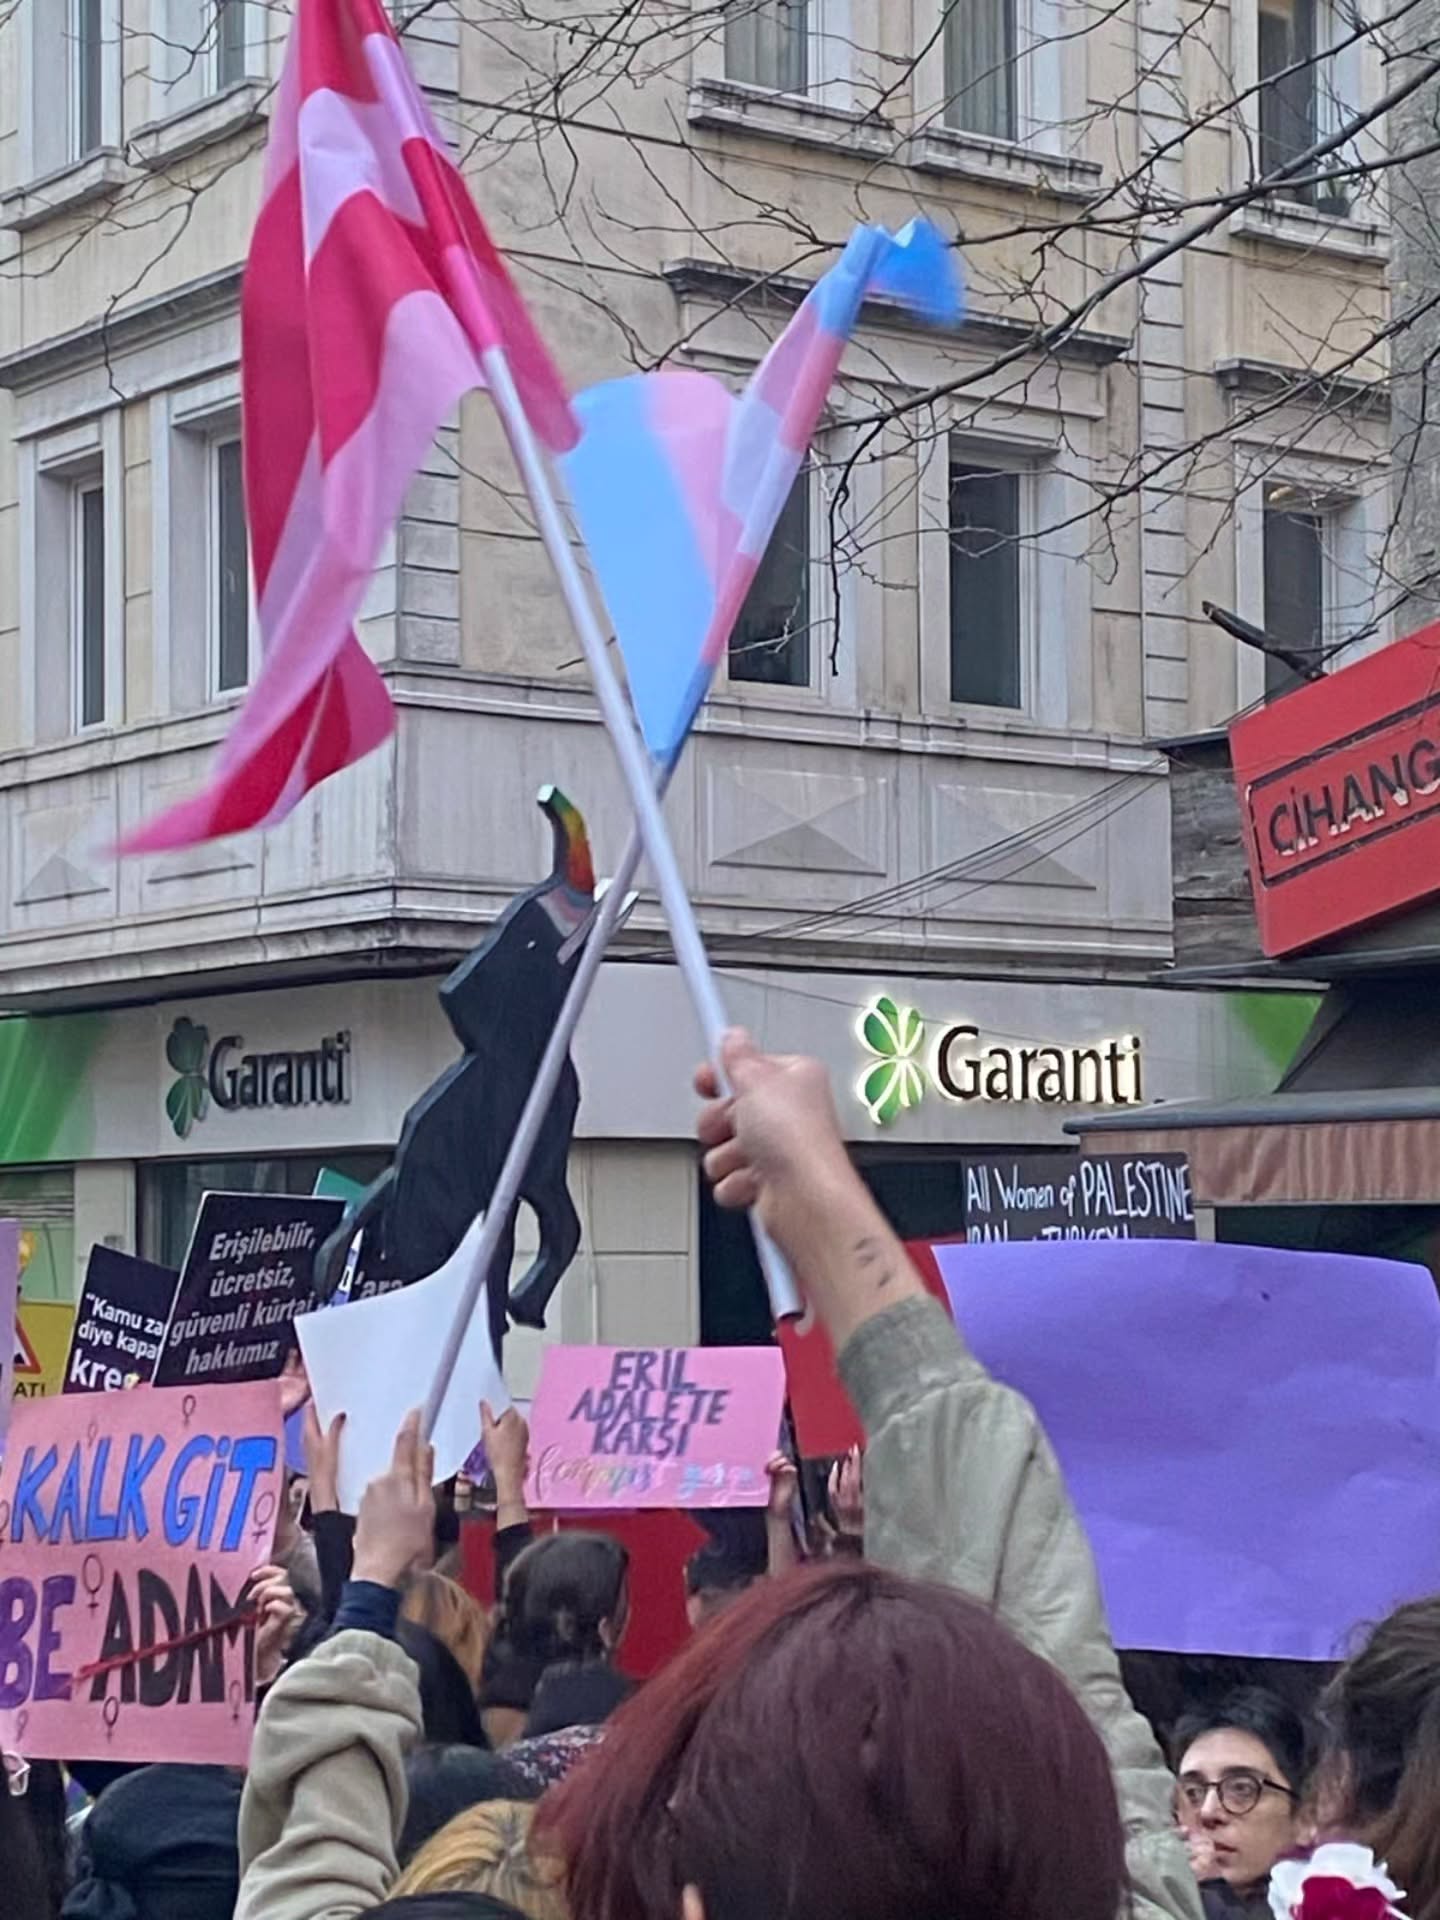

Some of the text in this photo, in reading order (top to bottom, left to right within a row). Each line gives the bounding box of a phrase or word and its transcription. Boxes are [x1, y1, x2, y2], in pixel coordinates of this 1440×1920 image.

[209, 1029, 351, 1110] Garanti
[937, 1024, 1142, 1104] Garanti
[967, 1160, 1195, 1224] All Women of PALESTINE
[209, 1221, 316, 1264] Erişilebilir,
[209, 1261, 295, 1298] ücretsiz,
[78, 1319, 114, 1347] diye
[169, 1303, 250, 1347] güvenli
[69, 1347, 124, 1392] kre
[184, 1340, 280, 1376] hakkımız
[568, 1387, 731, 1425] ADALETE
[11, 1434, 167, 1545] KALK
[0, 1562, 259, 1709] BE ADAM
